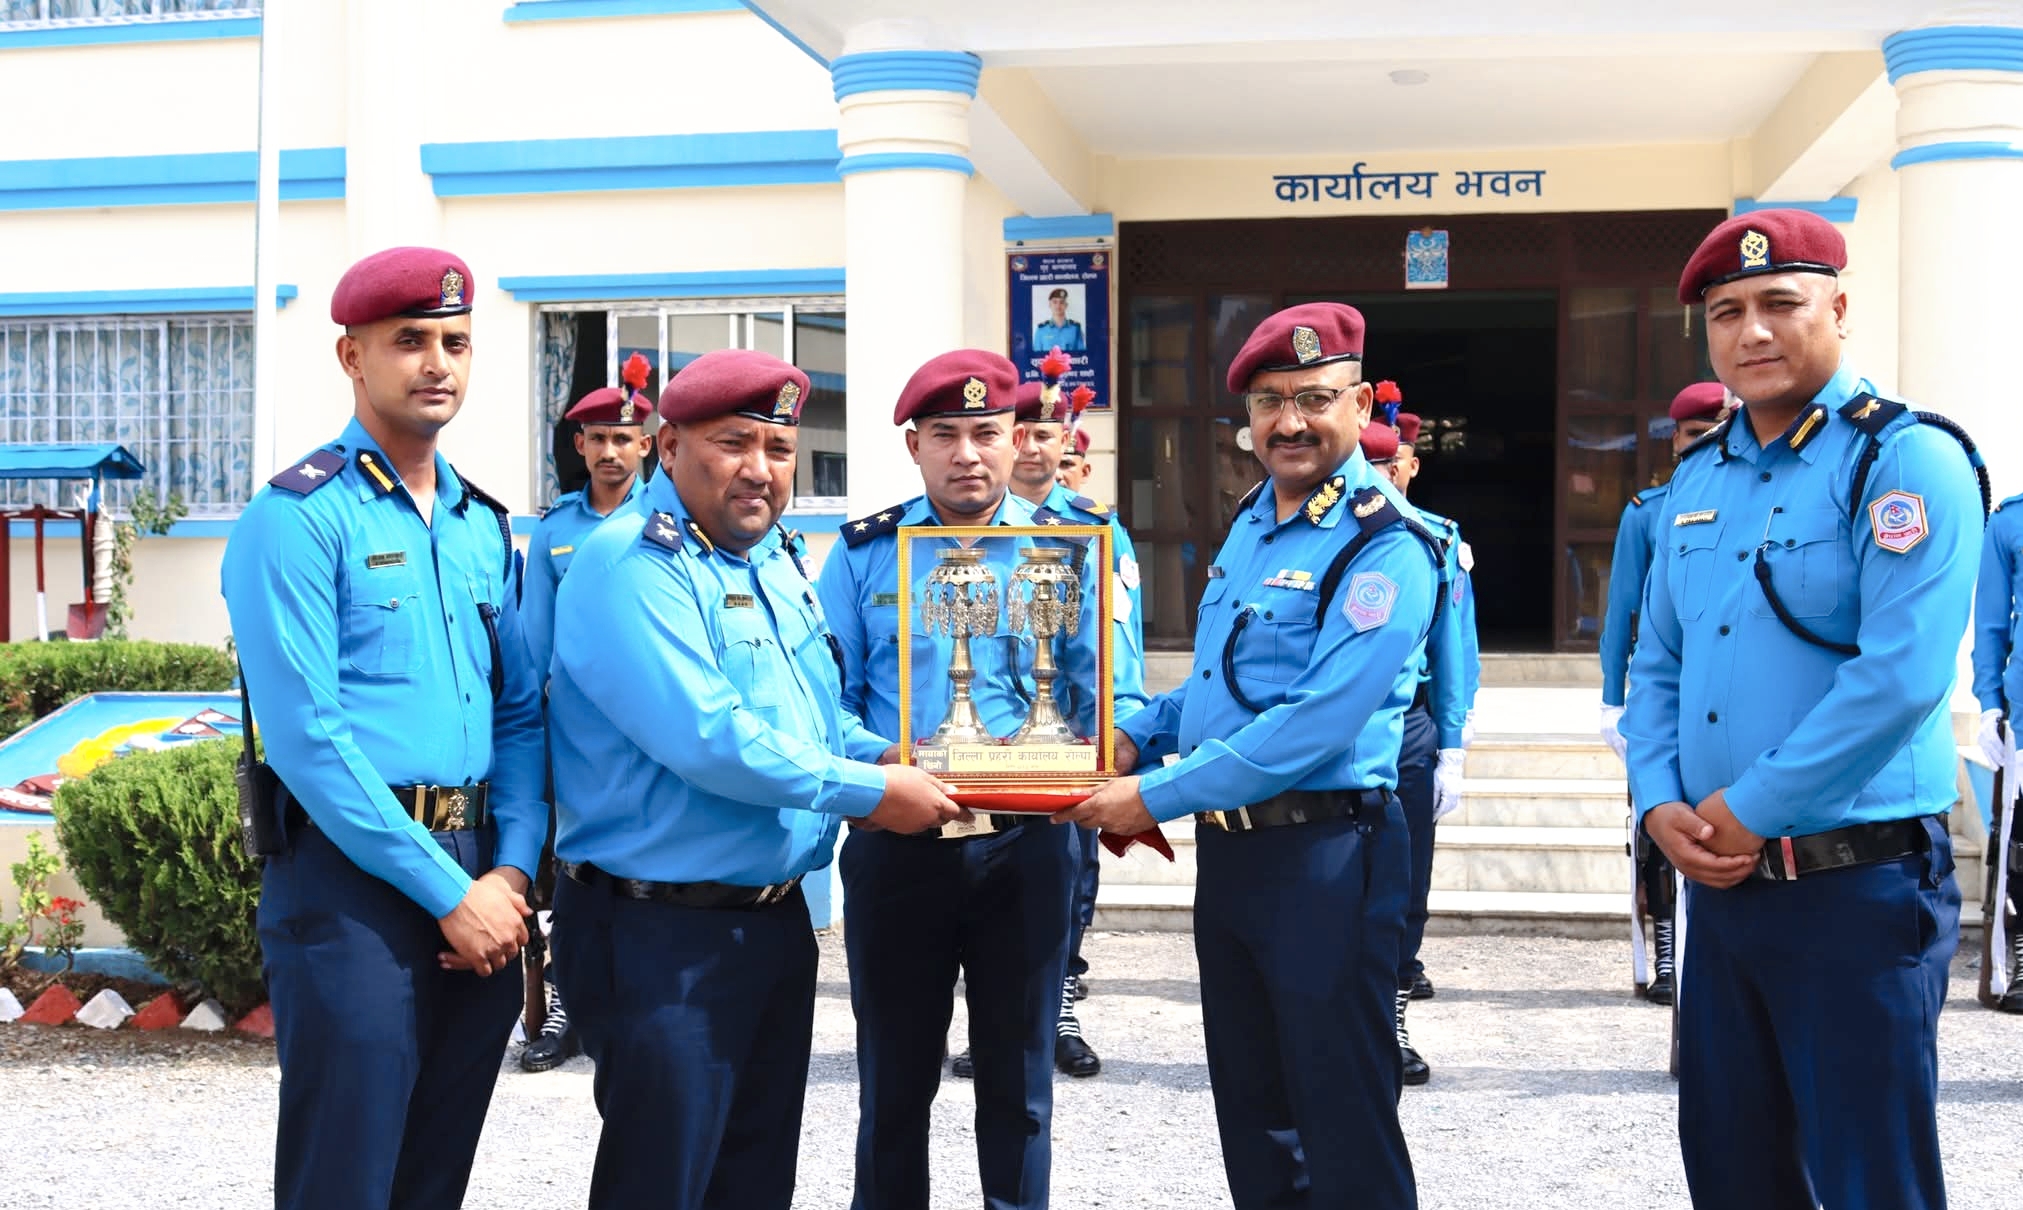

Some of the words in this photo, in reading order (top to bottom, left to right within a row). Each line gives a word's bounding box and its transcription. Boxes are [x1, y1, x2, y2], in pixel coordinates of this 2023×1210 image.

[1273, 162, 1439, 202] कार्यालय
[1455, 170, 1546, 198] भवन
[952, 748, 983, 762] जिल्ला
[988, 748, 1012, 762] प्रहरी
[1018, 747, 1059, 761] कार्यालय
